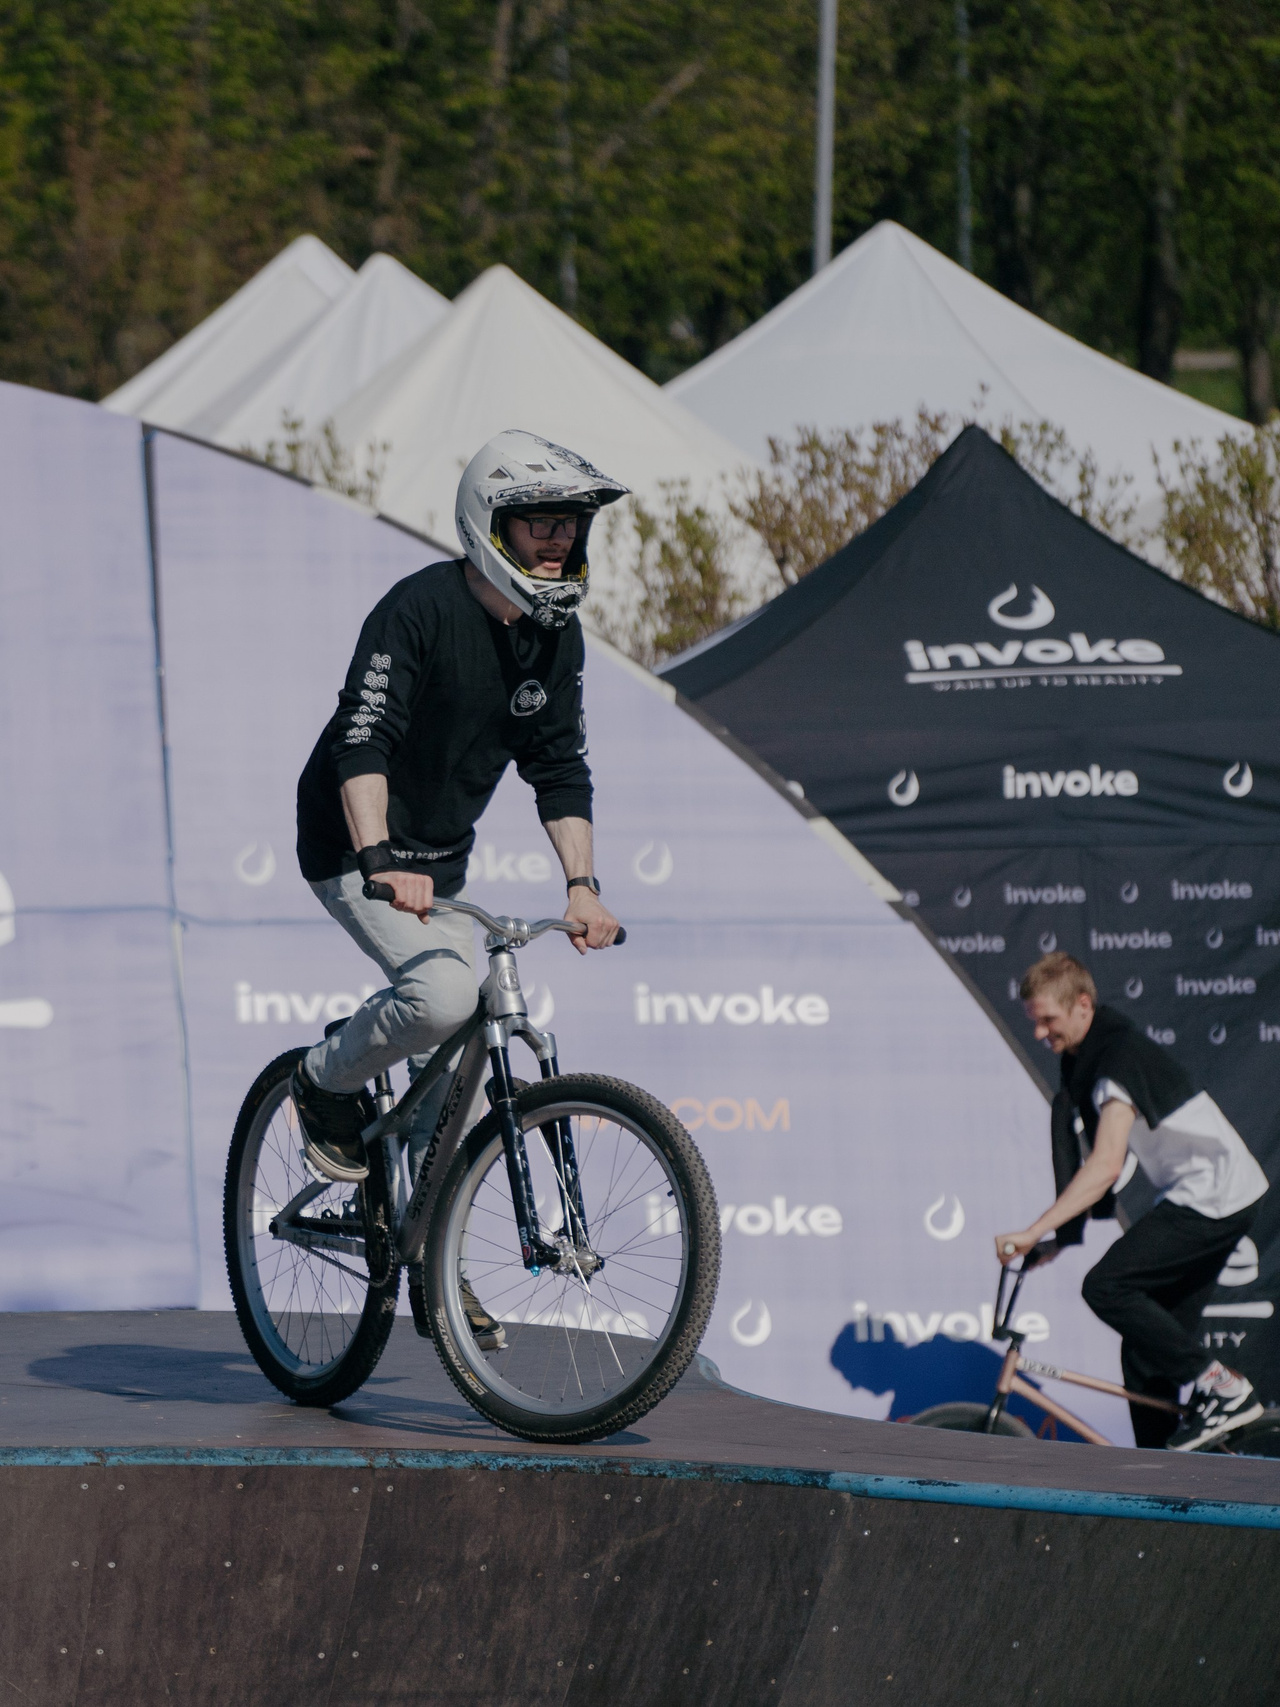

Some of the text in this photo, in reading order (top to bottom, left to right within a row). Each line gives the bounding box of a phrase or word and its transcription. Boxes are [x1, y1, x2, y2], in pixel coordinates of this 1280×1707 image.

[904, 632, 1166, 671] invoke
[1002, 763, 1139, 799] invoke
[1004, 882, 1086, 905] invoke
[1171, 878, 1253, 902] invoke
[1090, 928, 1173, 951] invoke
[234, 979, 378, 1024] invo
[1175, 973, 1257, 996] invoke
[634, 982, 830, 1026] invoke
[435, 1308, 486, 1396] CONTINENTAL
